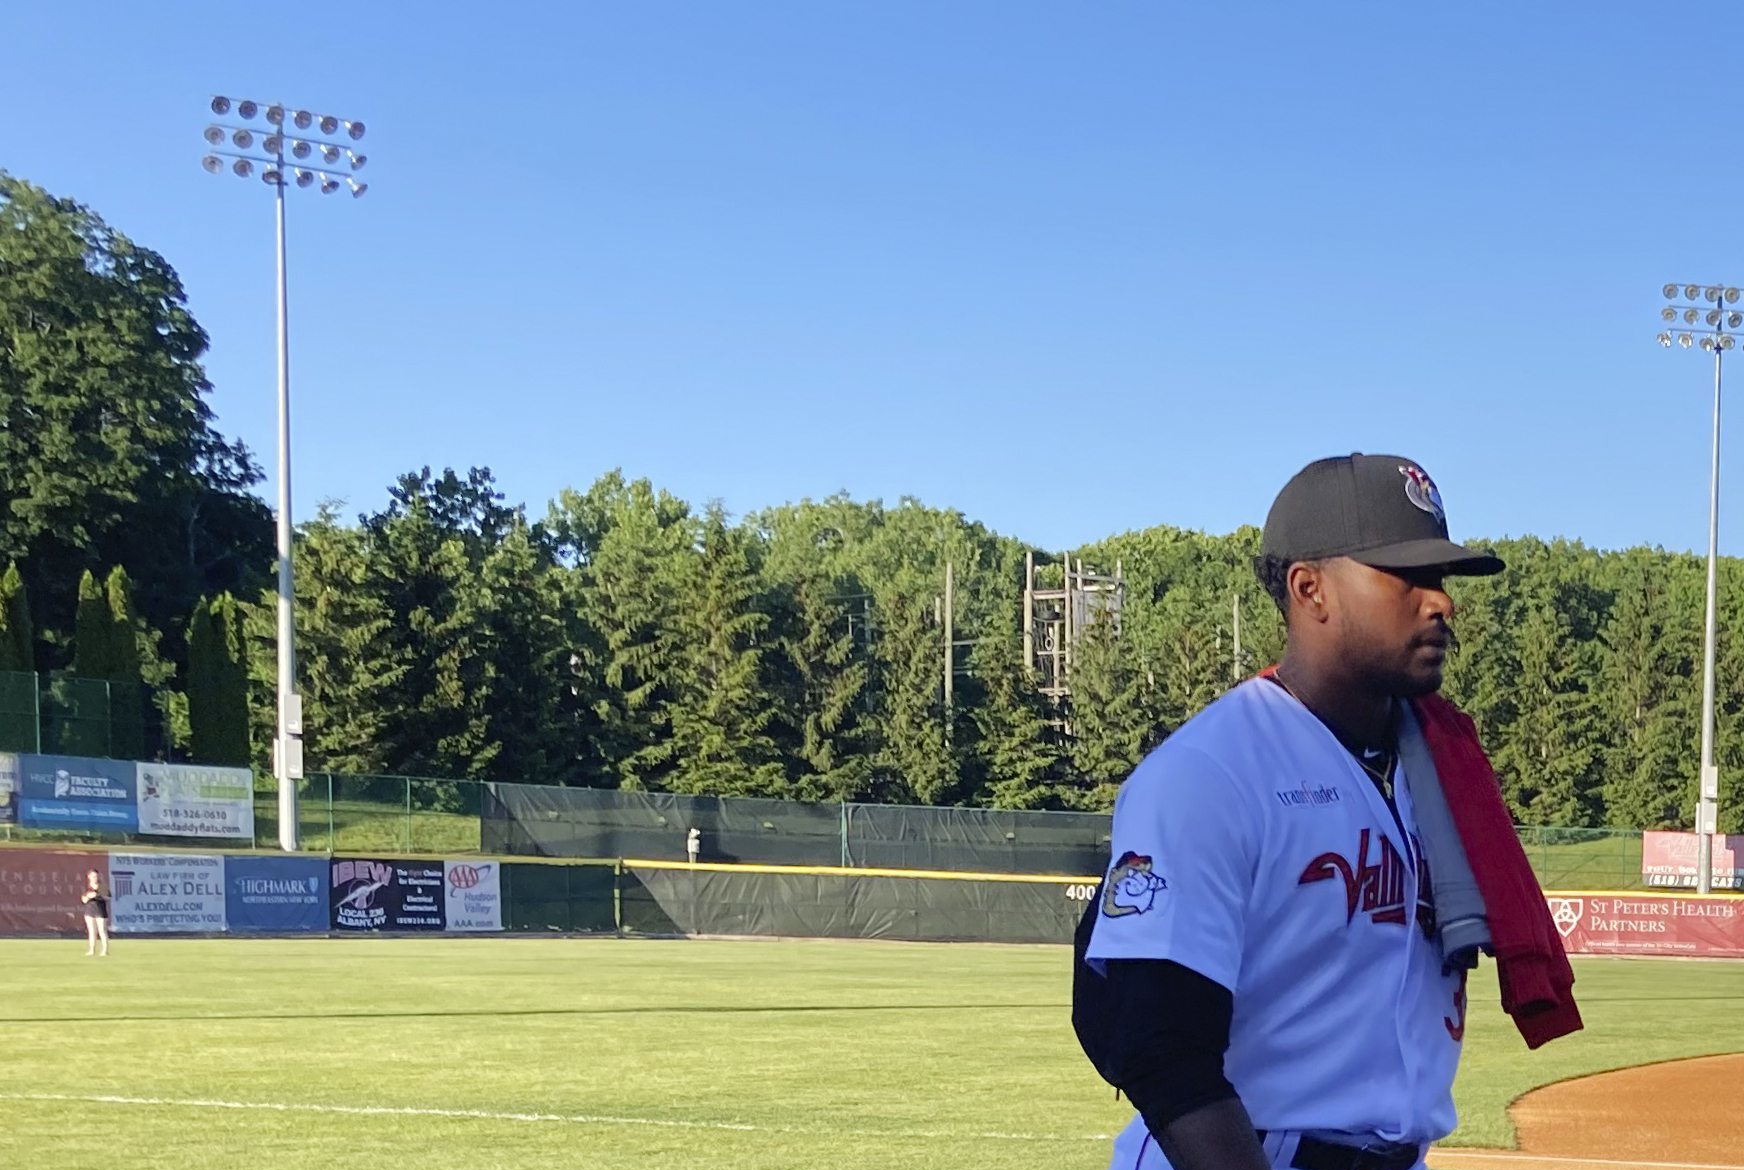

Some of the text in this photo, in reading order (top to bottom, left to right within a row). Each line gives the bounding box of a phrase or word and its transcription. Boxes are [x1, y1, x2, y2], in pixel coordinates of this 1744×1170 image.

[70, 776, 109, 787] FACULTY
[70, 786, 127, 798] ASSOCIATION
[150, 872, 171, 881] LAW
[172, 873, 195, 881] FIRM
[332, 861, 393, 888] IBEW
[138, 882, 223, 896] ALEX DELL
[241, 880, 306, 894] HIGHMARK
[1066, 884, 1096, 901] 400
[464, 892, 498, 902] Hudson
[135, 902, 203, 911] ALEXDELL.COM
[339, 907, 367, 918] LOCAL
[464, 903, 492, 915] Valley
[337, 915, 387, 927] ALBANY, NY
[1590, 915, 1666, 933] PARTNERS
